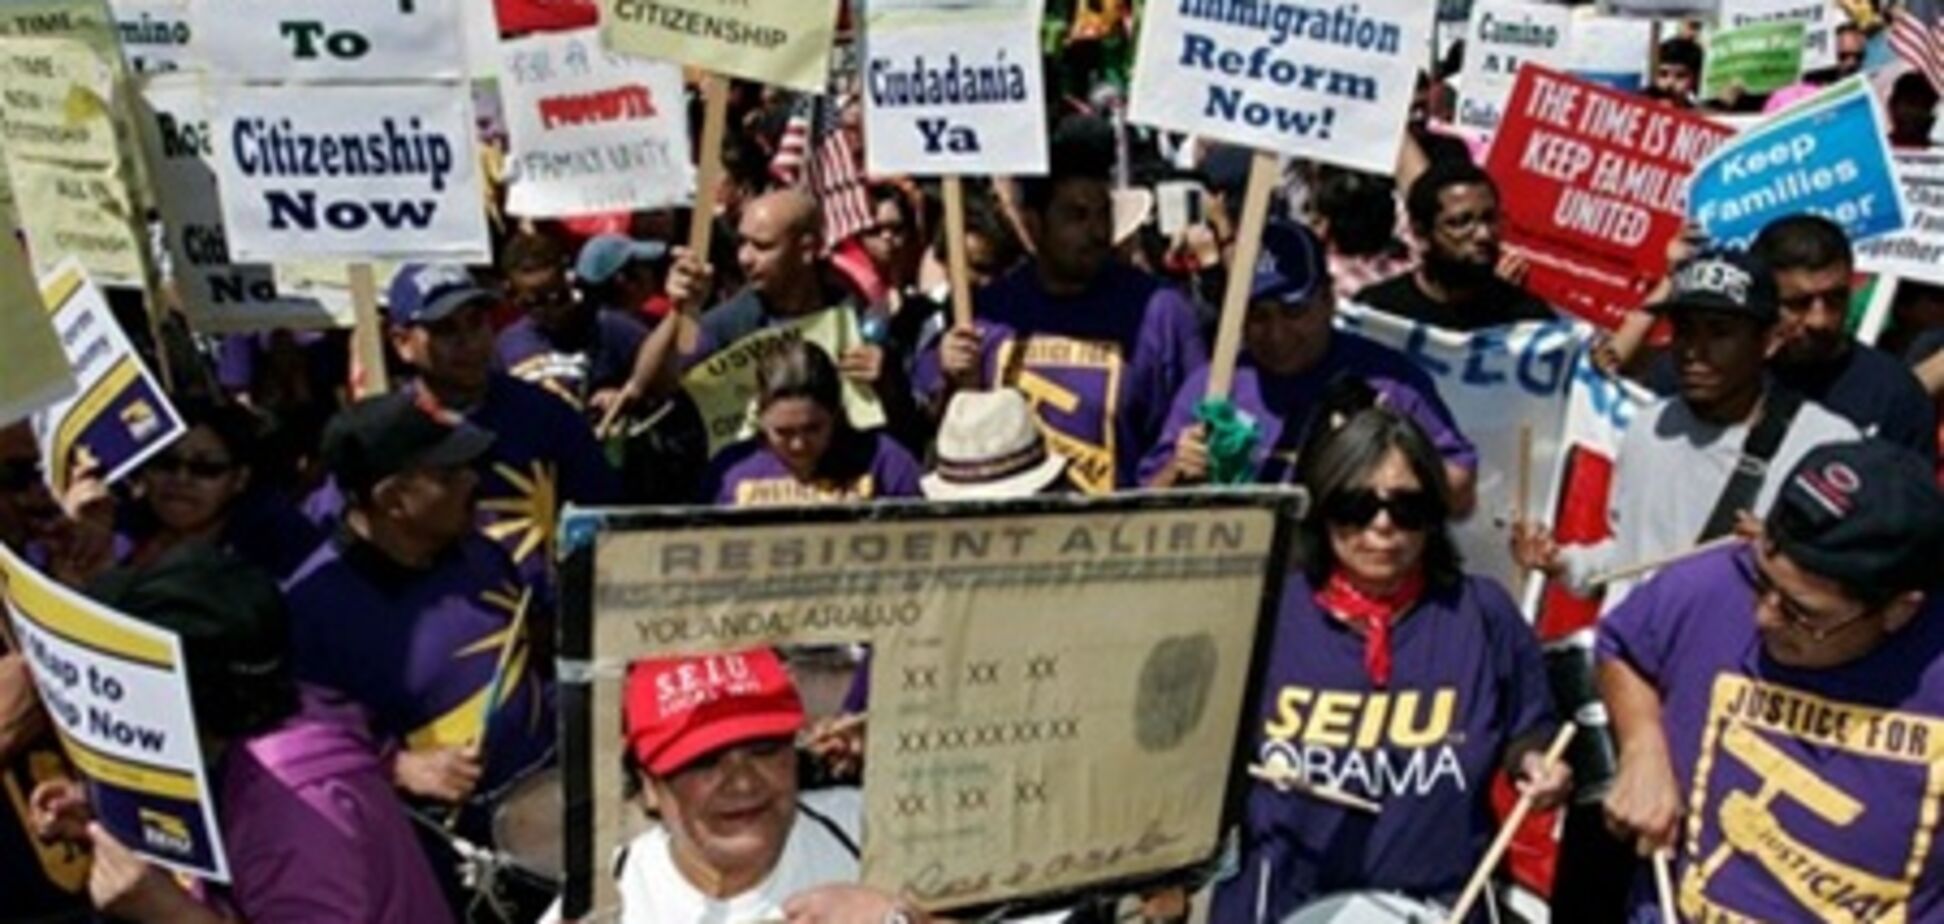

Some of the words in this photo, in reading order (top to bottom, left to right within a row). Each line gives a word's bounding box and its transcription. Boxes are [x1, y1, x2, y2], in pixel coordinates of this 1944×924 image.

[279, 21, 371, 60] To
[614, 0, 789, 48] CITIZENSHIP
[1178, 34, 1378, 102] Reform
[916, 119, 981, 154] Ya
[1204, 86, 1337, 139] Now!
[1524, 75, 1581, 128] THE
[1577, 92, 1646, 149] TIME
[1640, 113, 1674, 156] IS
[232, 115, 453, 191] Citizenship
[1519, 128, 1594, 183] KEEP
[1720, 132, 1817, 186] Keep
[263, 190, 437, 230] Now
[1553, 184, 1652, 244] UNITED
[1697, 157, 1860, 226] Families
[660, 527, 1034, 575] RESIDENT
[1060, 521, 1245, 557] ALIEN
[86, 664, 125, 702] to
[88, 707, 164, 752] Now
[1265, 685, 1459, 750] SEIU
[1727, 685, 1852, 744] JUSTICE
[1865, 716, 1930, 757] FOR
